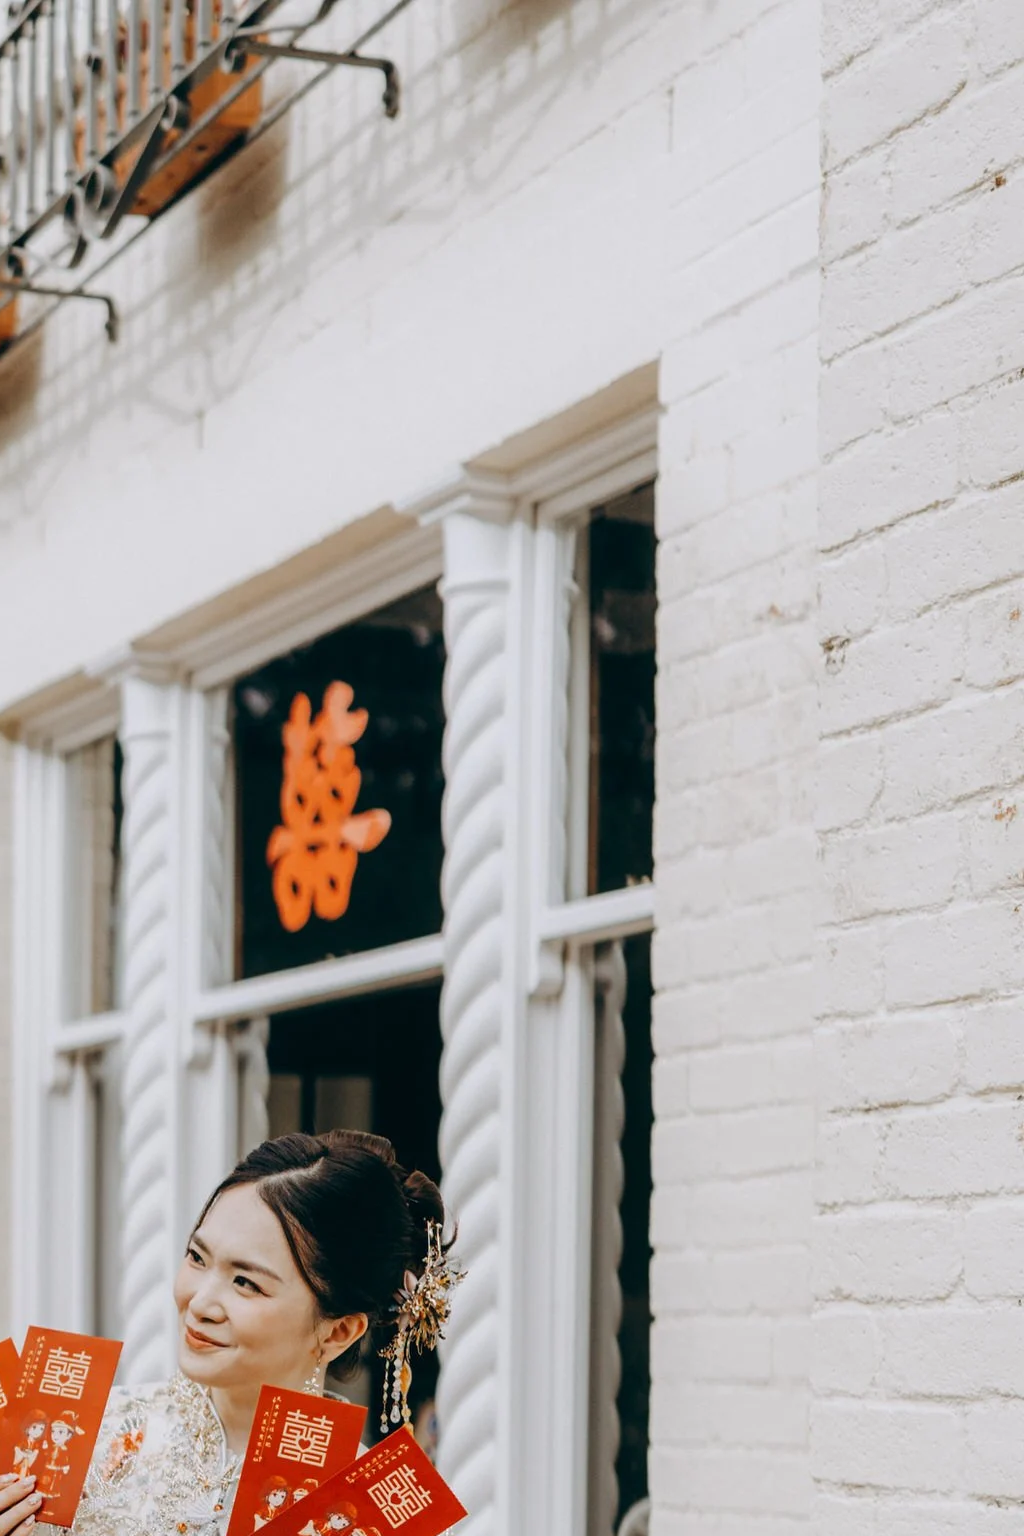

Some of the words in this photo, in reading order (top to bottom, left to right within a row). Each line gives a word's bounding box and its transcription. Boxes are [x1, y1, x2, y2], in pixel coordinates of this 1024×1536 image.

[39, 1346, 92, 1400] 囍
[277, 1409, 334, 1468] 囍
[367, 1463, 433, 1529] 囍
